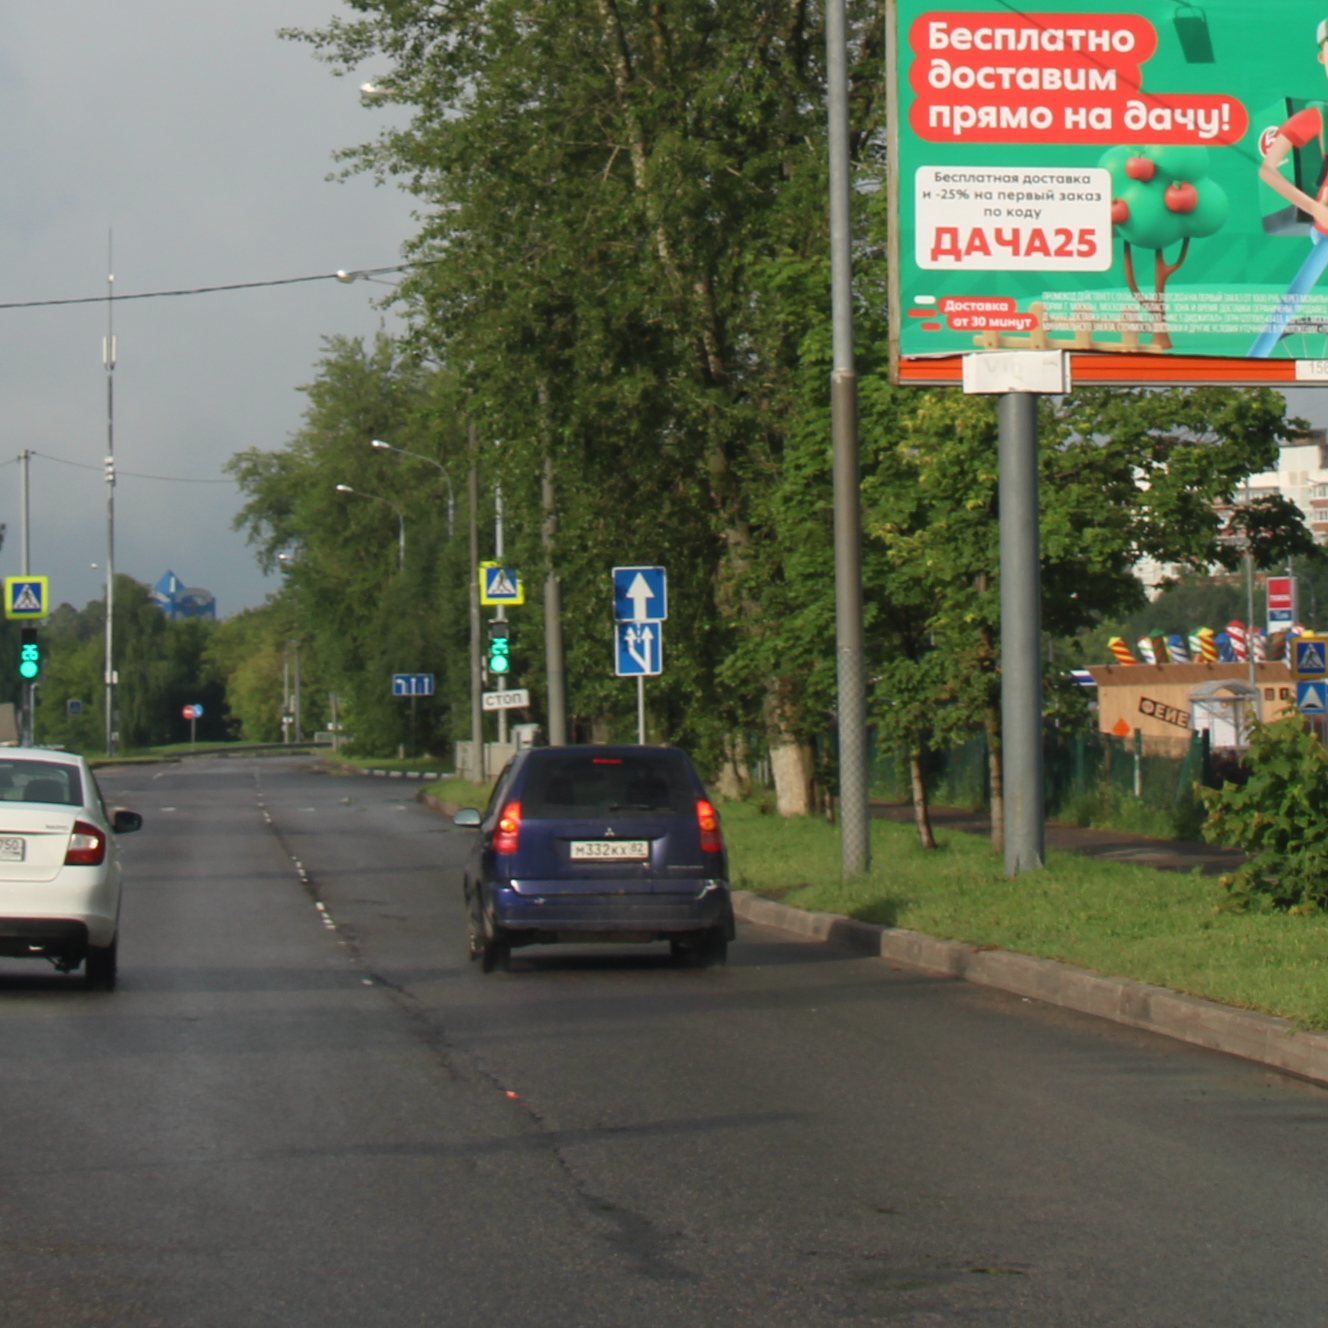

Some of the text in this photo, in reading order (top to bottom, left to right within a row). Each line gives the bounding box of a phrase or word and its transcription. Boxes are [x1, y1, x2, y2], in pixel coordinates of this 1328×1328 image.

[928, 21, 1136, 53] Бесплатно
[927, 58, 1117, 91] доставим
[928, 99, 1231, 139] прямо на дачу!
[934, 172, 1091, 185] Бесплатная доставка
[922, 189, 1102, 203] и -25% на первый заказ
[983, 208, 1042, 220] по коду
[930, 227, 1098, 262] ДАЧА25
[944, 300, 1009, 313] Доставка
[953, 317, 1032, 330] от 30 минут
[485, 692, 522, 707] СТОП
